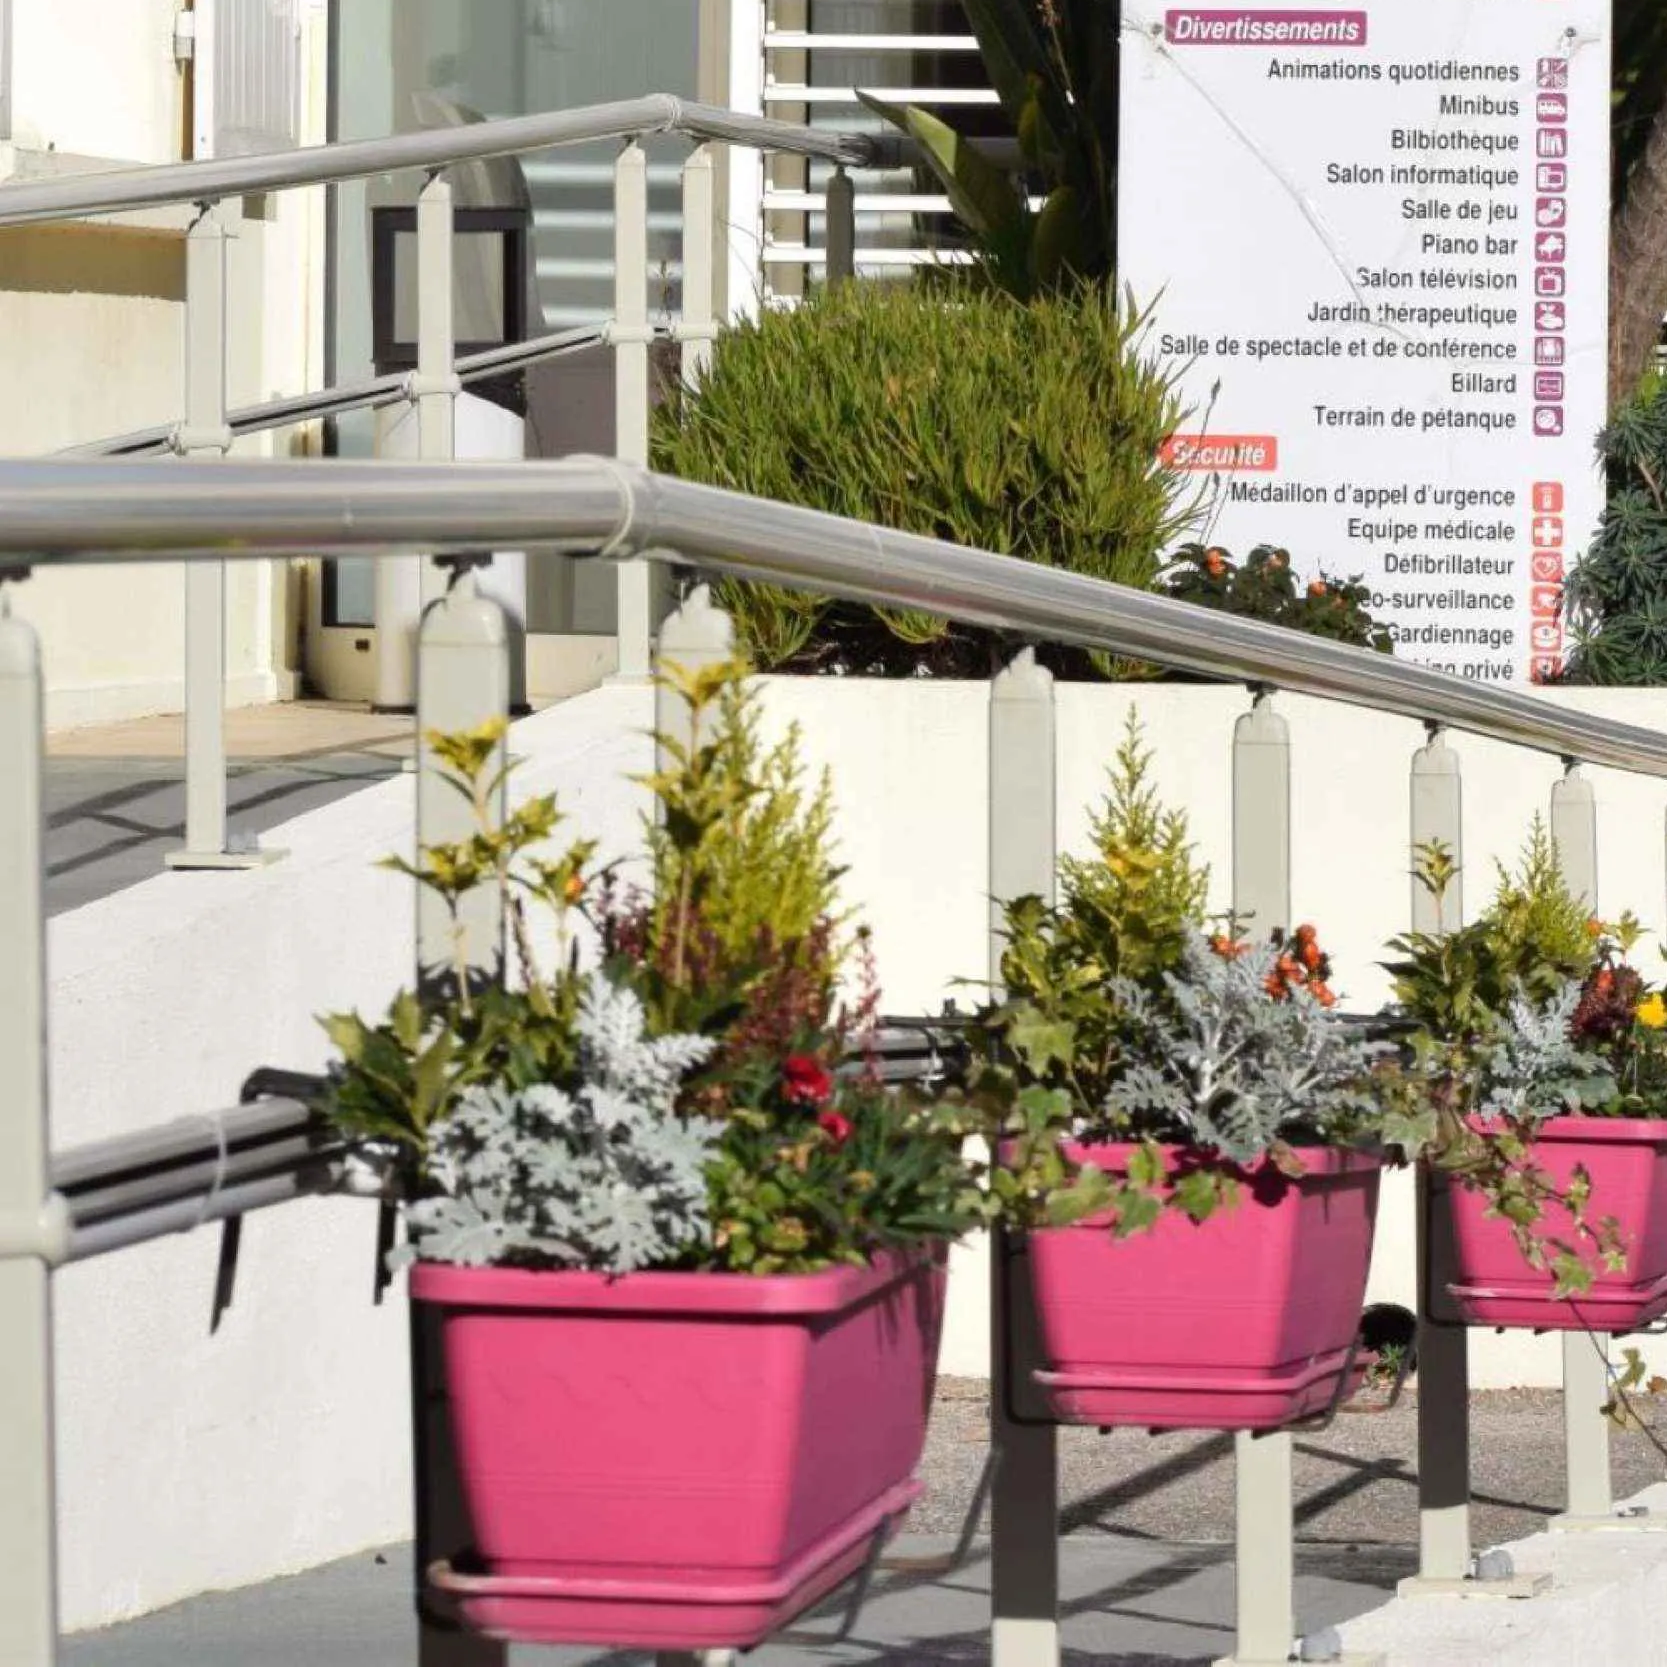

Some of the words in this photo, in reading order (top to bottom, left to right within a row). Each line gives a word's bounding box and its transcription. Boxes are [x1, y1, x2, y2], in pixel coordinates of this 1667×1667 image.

[1175, 16, 1358, 40] Divertissements
[1267, 59, 1382, 80] Animations
[1388, 61, 1519, 85] quotidiennes
[1440, 94, 1519, 116] Minibus
[1327, 162, 1384, 184] Salon
[1390, 164, 1519, 188] informatique
[1402, 199, 1451, 220] Salle
[1457, 200, 1482, 220] de
[1488, 204, 1518, 225] jeu
[1422, 234, 1479, 255] Piano
[1485, 235, 1517, 255] bar
[1357, 267, 1413, 288] Salon
[1420, 269, 1517, 290] télévision
[1307, 301, 1371, 323] Jardin
[1159, 334, 1209, 355] Salle
[1215, 336, 1240, 356] de
[1246, 336, 1342, 360] spectacle
[1347, 338, 1366, 357] et
[1372, 337, 1397, 358] de
[1403, 338, 1517, 359] conférence
[1452, 372, 1517, 393] Billard
[1314, 405, 1384, 427] Terrain
[1390, 408, 1416, 428] de
[1422, 409, 1516, 432] pétanque
[1230, 481, 1327, 503] Médaillon
[1334, 483, 1407, 509] d'appel
[1414, 485, 1515, 511] d'urgence
[1347, 517, 1417, 544] Equipe
[1424, 520, 1515, 541] médicale
[1384, 553, 1514, 575] Défibrillateur
